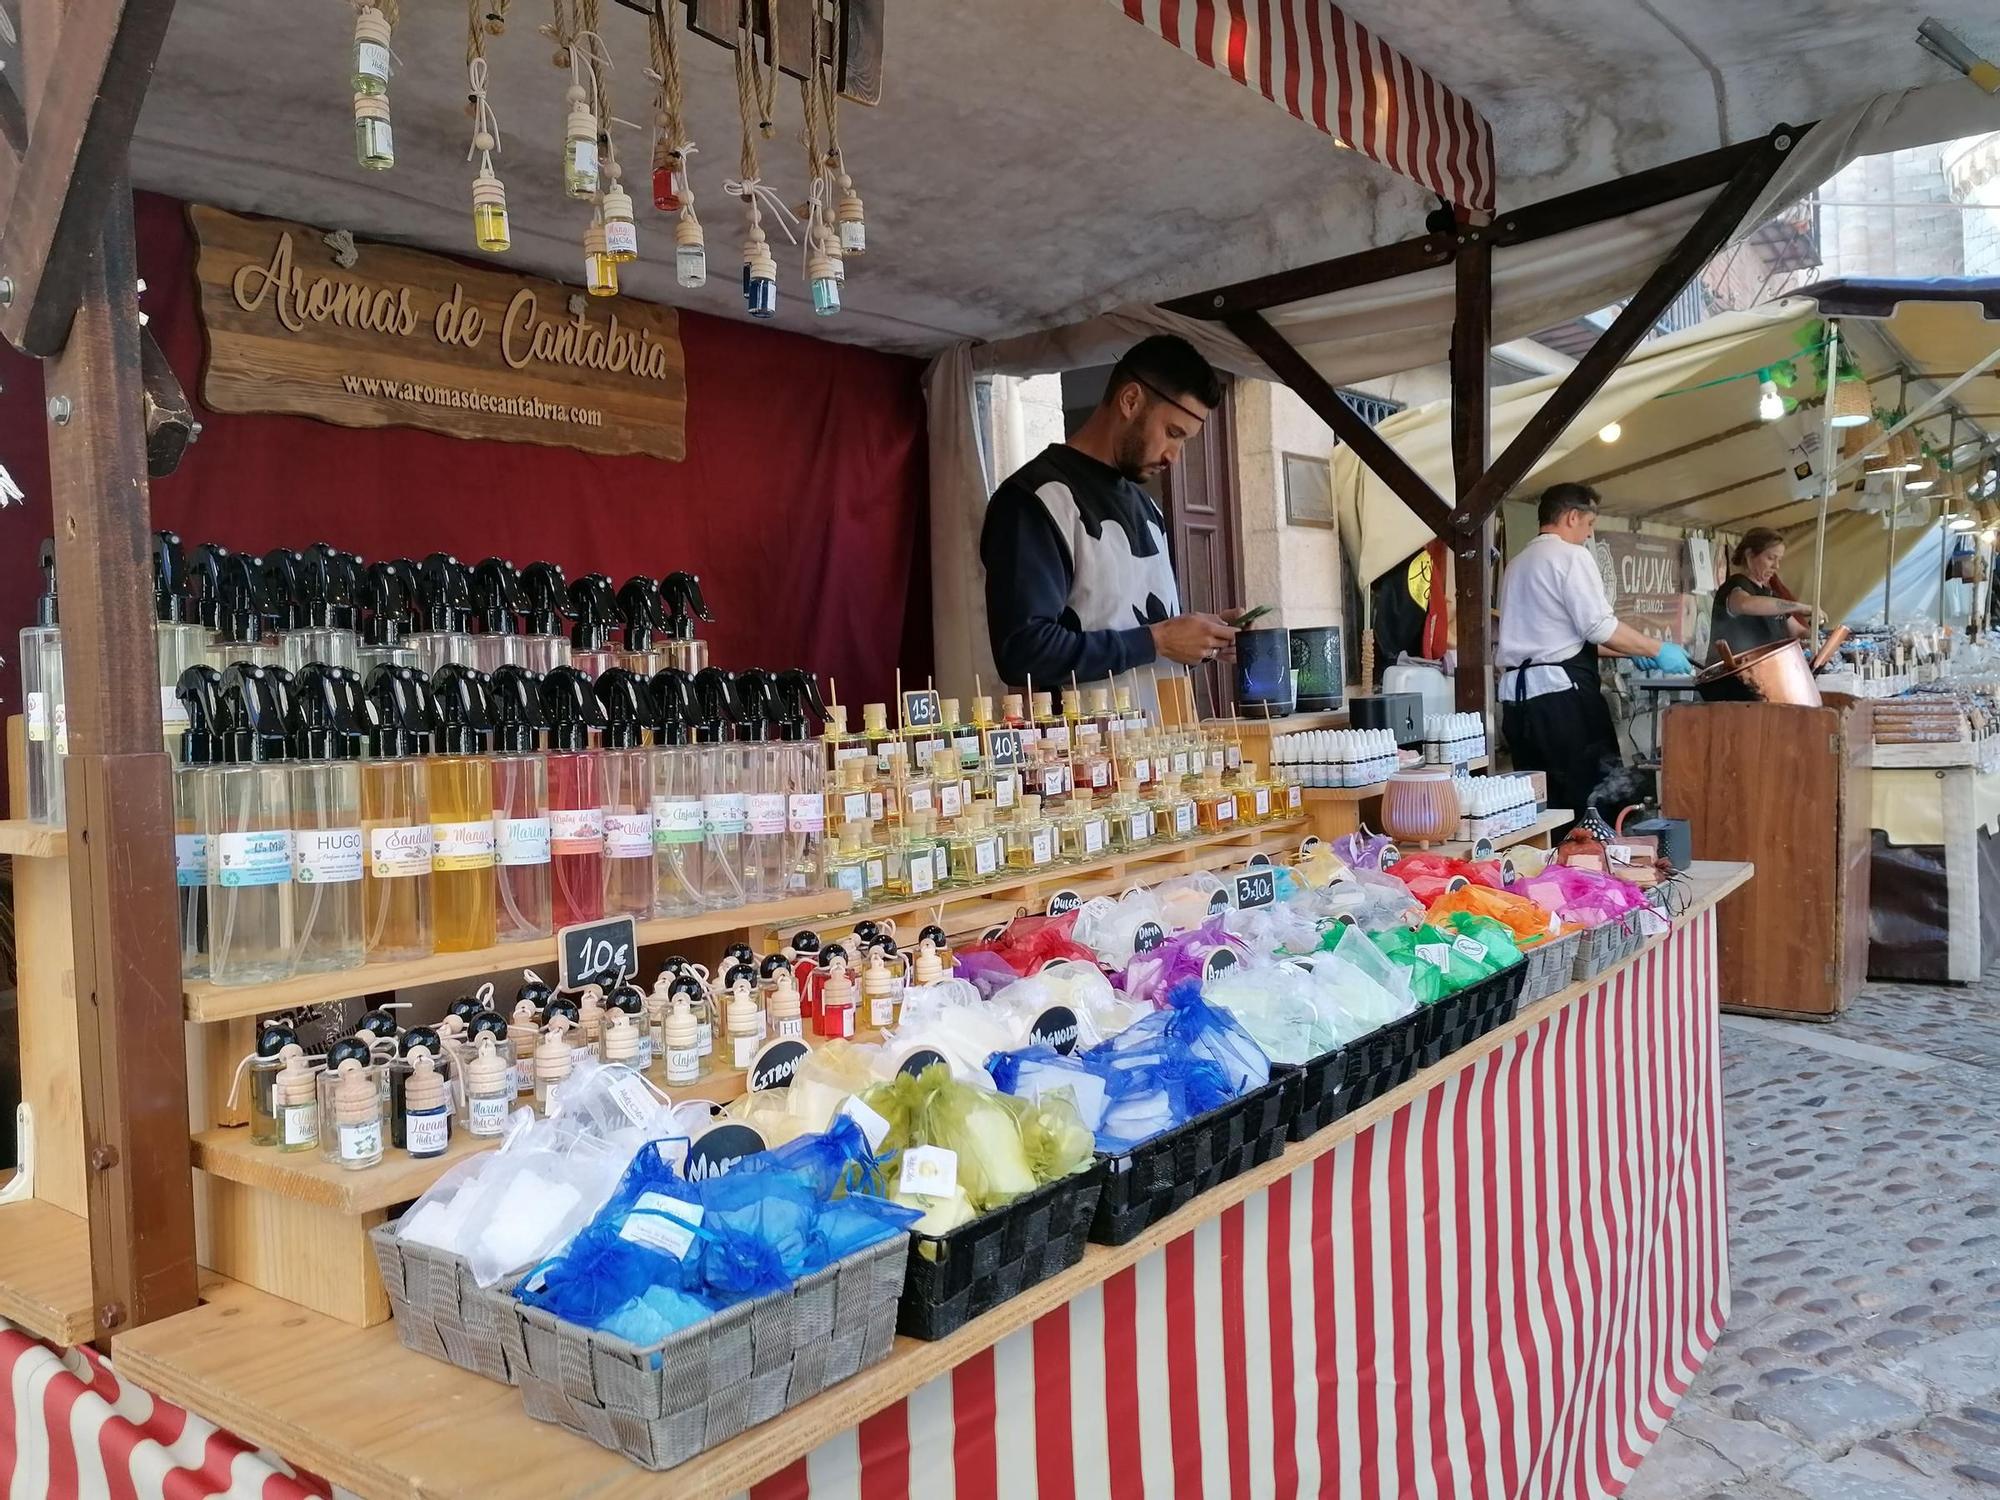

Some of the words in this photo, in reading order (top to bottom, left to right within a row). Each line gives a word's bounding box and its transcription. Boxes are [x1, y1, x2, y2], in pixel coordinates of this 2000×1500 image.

[233, 231, 420, 335] Aromas
[436, 284, 486, 348] de
[501, 288, 667, 380] Cantabria
[343, 375, 602, 426] www.aromasdecantabria.com
[912, 697, 936, 720] 15€
[995, 736, 1020, 759] 10€
[317, 834, 361, 850] HUGO
[1239, 877, 1272, 901] 3x10€
[1053, 897, 1082, 910] DULCES
[1139, 924, 1161, 939] DAMA
[577, 936, 628, 980] 10€
